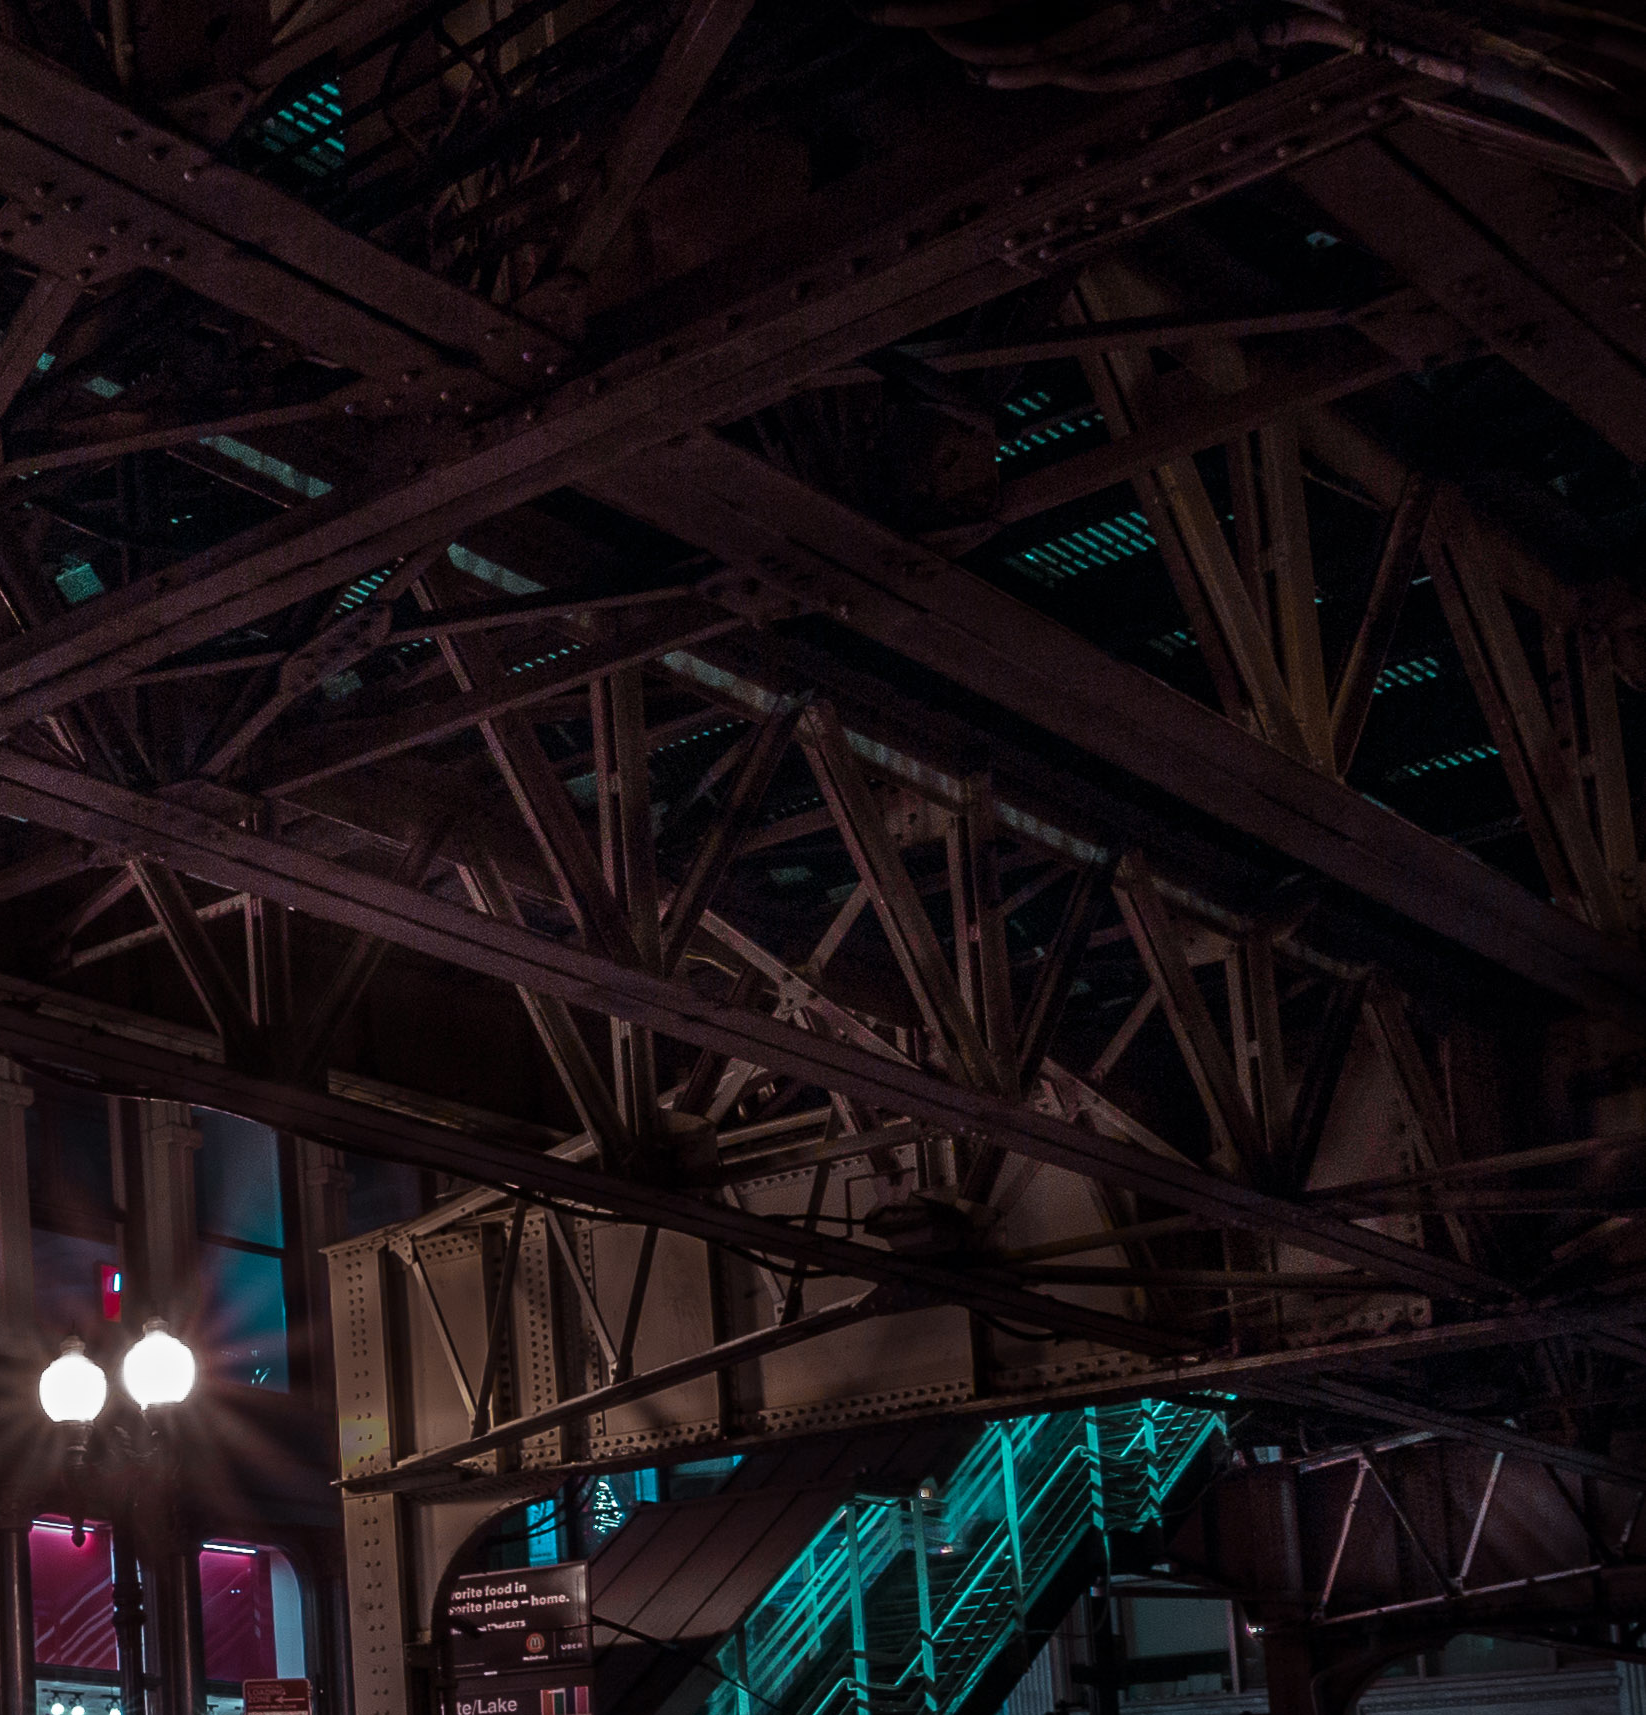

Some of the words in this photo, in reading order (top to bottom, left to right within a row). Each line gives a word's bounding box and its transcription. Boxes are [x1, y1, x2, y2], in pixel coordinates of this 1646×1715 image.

[484, 1583, 512, 1596] food
[514, 1582, 527, 1593] in
[485, 1600, 519, 1614] place
[531, 1595, 570, 1607] home.
